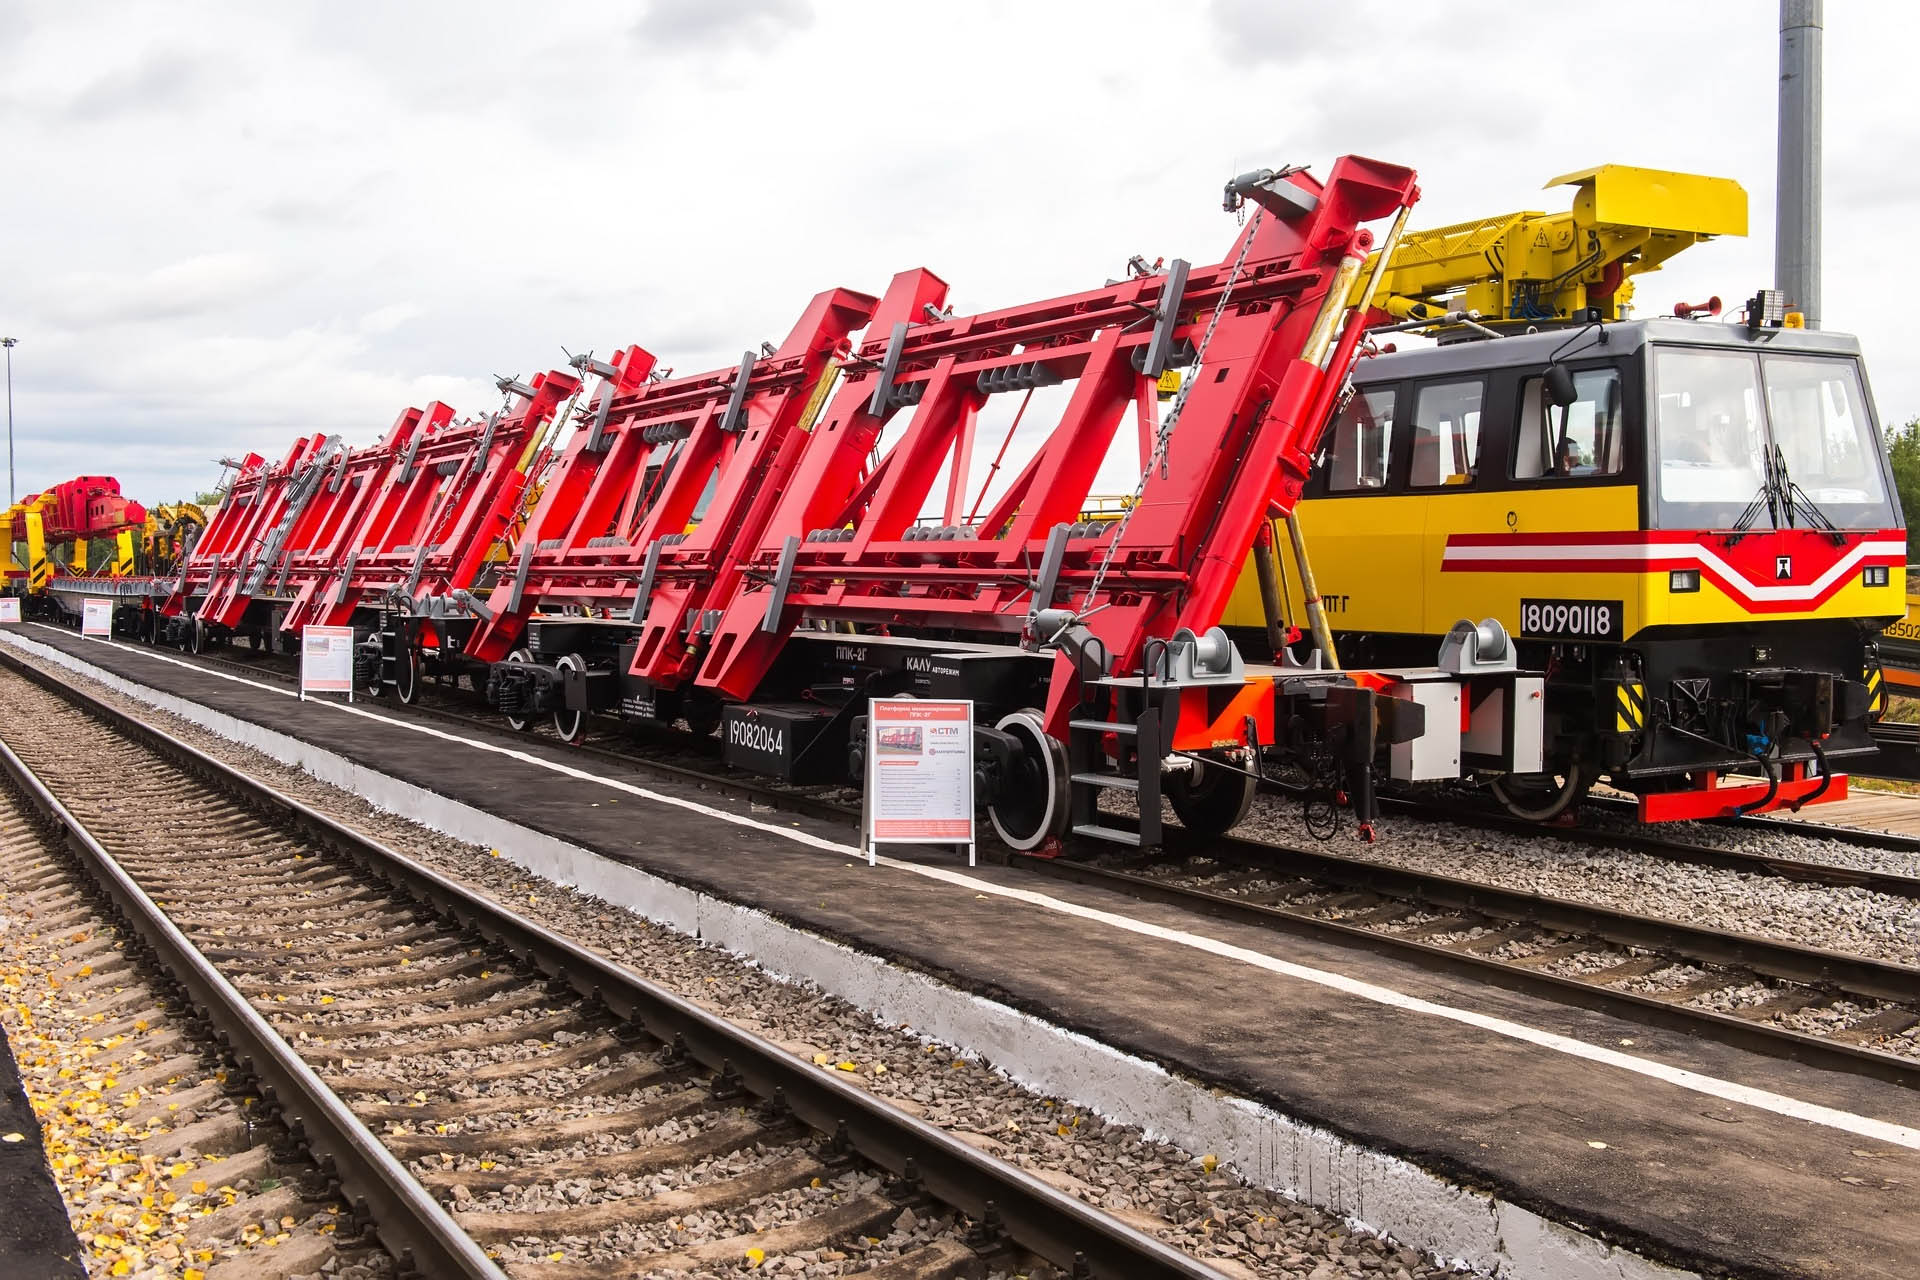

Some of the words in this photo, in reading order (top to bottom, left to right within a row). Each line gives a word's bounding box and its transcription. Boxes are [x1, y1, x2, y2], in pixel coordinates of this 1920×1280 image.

[1521, 604, 1611, 635] 18090118
[836, 646, 867, 661] ППК-2Г
[931, 666, 960, 677] АВТОРЕЖИМ
[730, 719, 783, 756] 19082064
